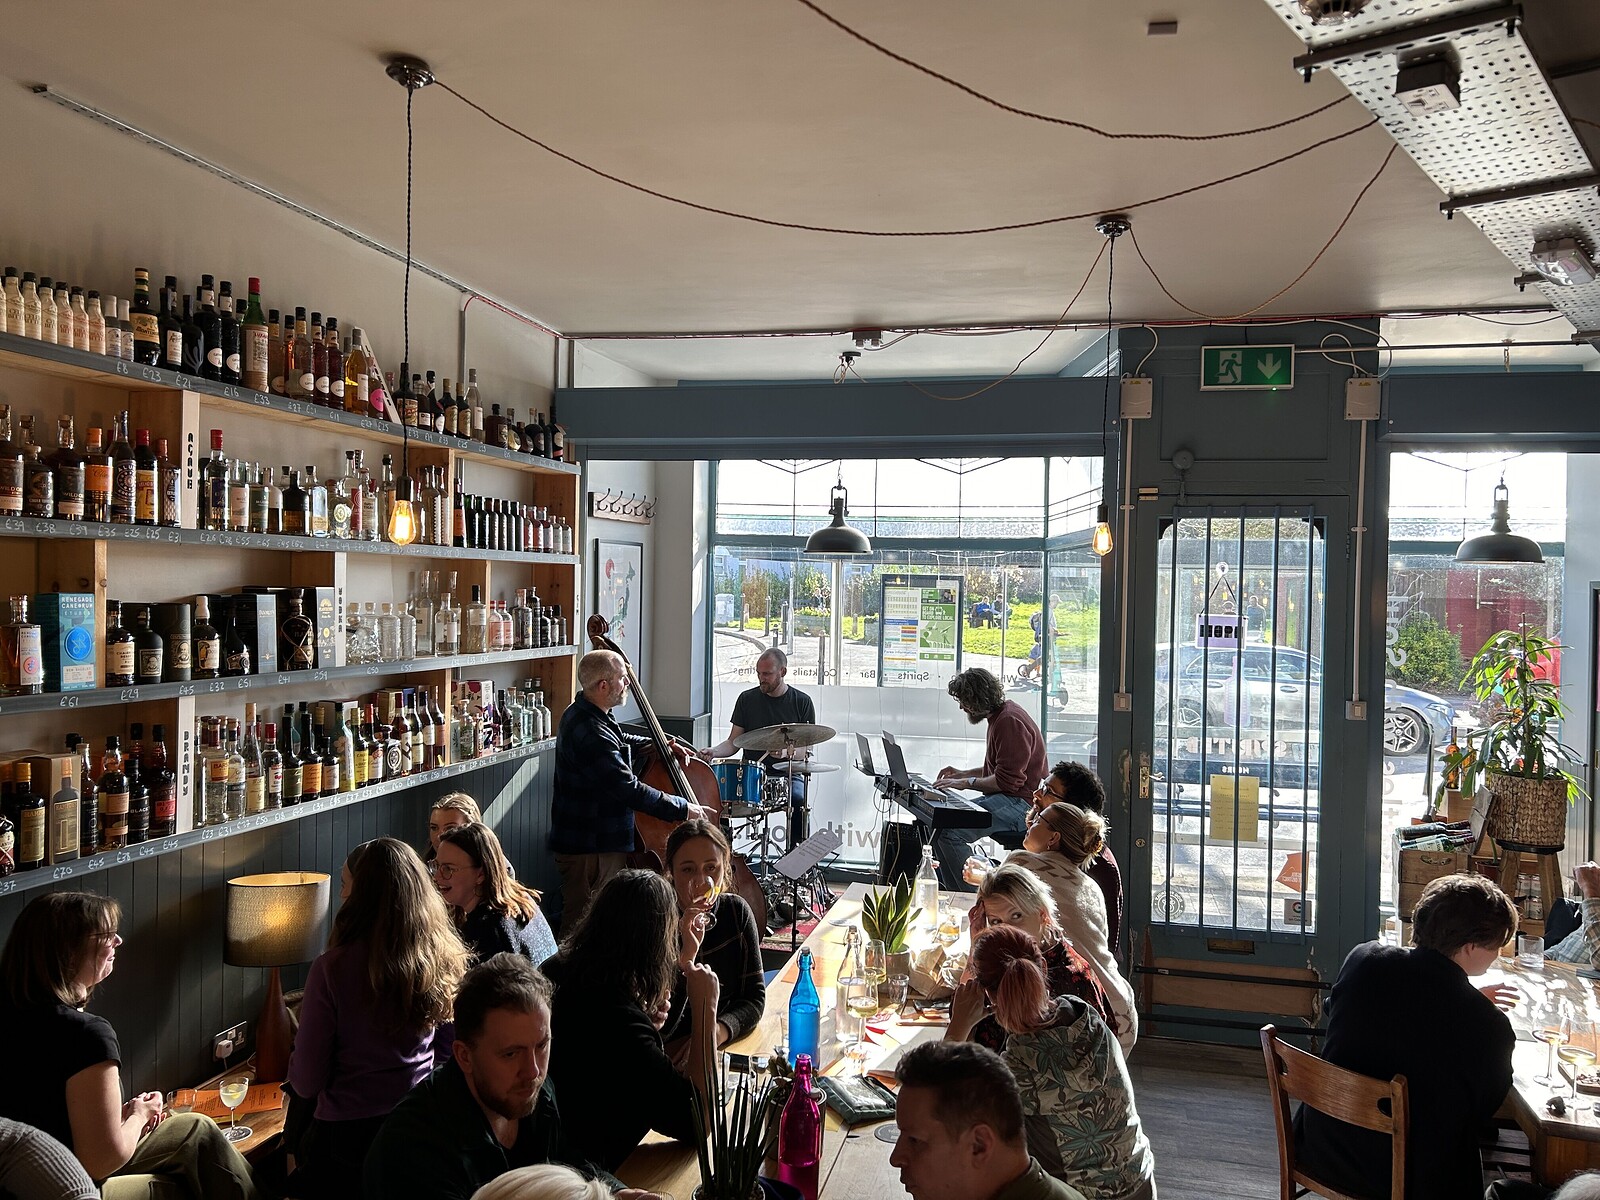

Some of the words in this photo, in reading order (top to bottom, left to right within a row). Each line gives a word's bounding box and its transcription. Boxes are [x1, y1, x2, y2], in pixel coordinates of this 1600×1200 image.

[116, 361, 129, 375] £8
[142, 367, 162, 382] £23
[175, 374, 191, 389] £21
[223, 386, 240, 397] £16
[254, 393, 271, 405] £33
[5, 518, 25, 532] £39
[36, 523, 56, 534] £38
[69, 524, 88, 536] £39
[97, 522, 116, 537] £35
[145, 527, 161, 540] £25
[209, 682, 225, 692] £32
[238, 678, 252, 689] £51
[120, 688, 139, 701] £29
[60, 696, 78, 707] £61
[182, 731, 190, 796] BRANDY
[255, 815, 269, 826] £50
[201, 829, 214, 840] £23
[218, 826, 232, 837] £31
[139, 845, 155, 856] £45
[163, 839, 179, 850] £45
[88, 857, 105, 870] £45
[52, 866, 73, 879] £70
